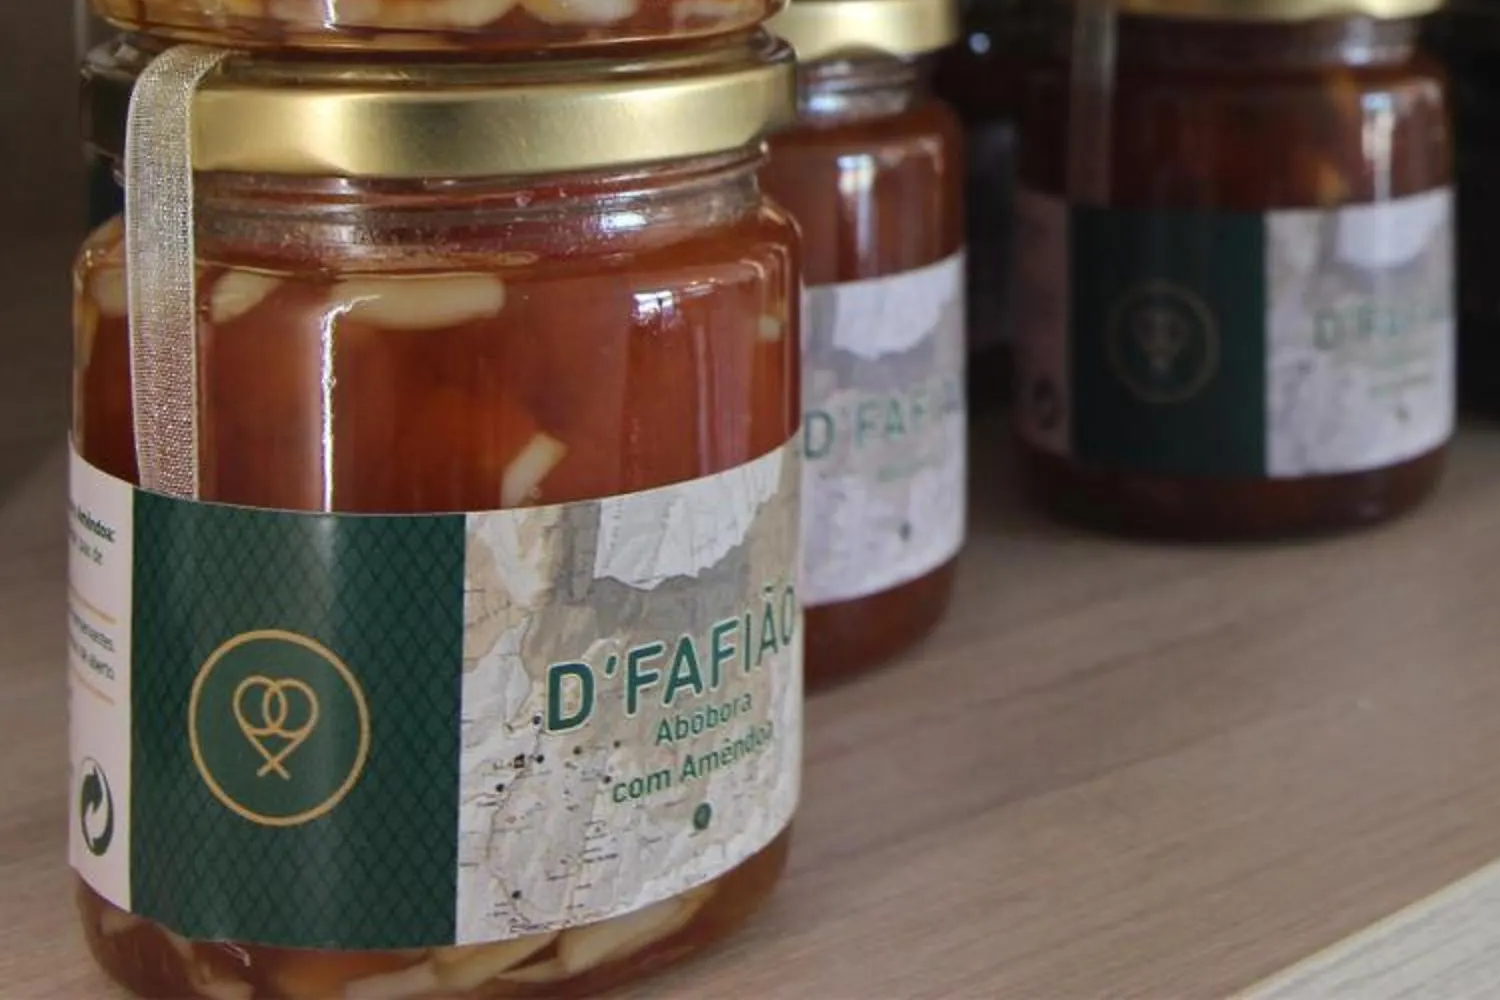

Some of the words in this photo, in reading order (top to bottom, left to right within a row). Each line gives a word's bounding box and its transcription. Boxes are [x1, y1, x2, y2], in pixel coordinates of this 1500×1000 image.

[547, 583, 796, 733] D'FAFIÃO
[612, 767, 672, 804] com
[679, 720, 775, 783] Amêndoa
